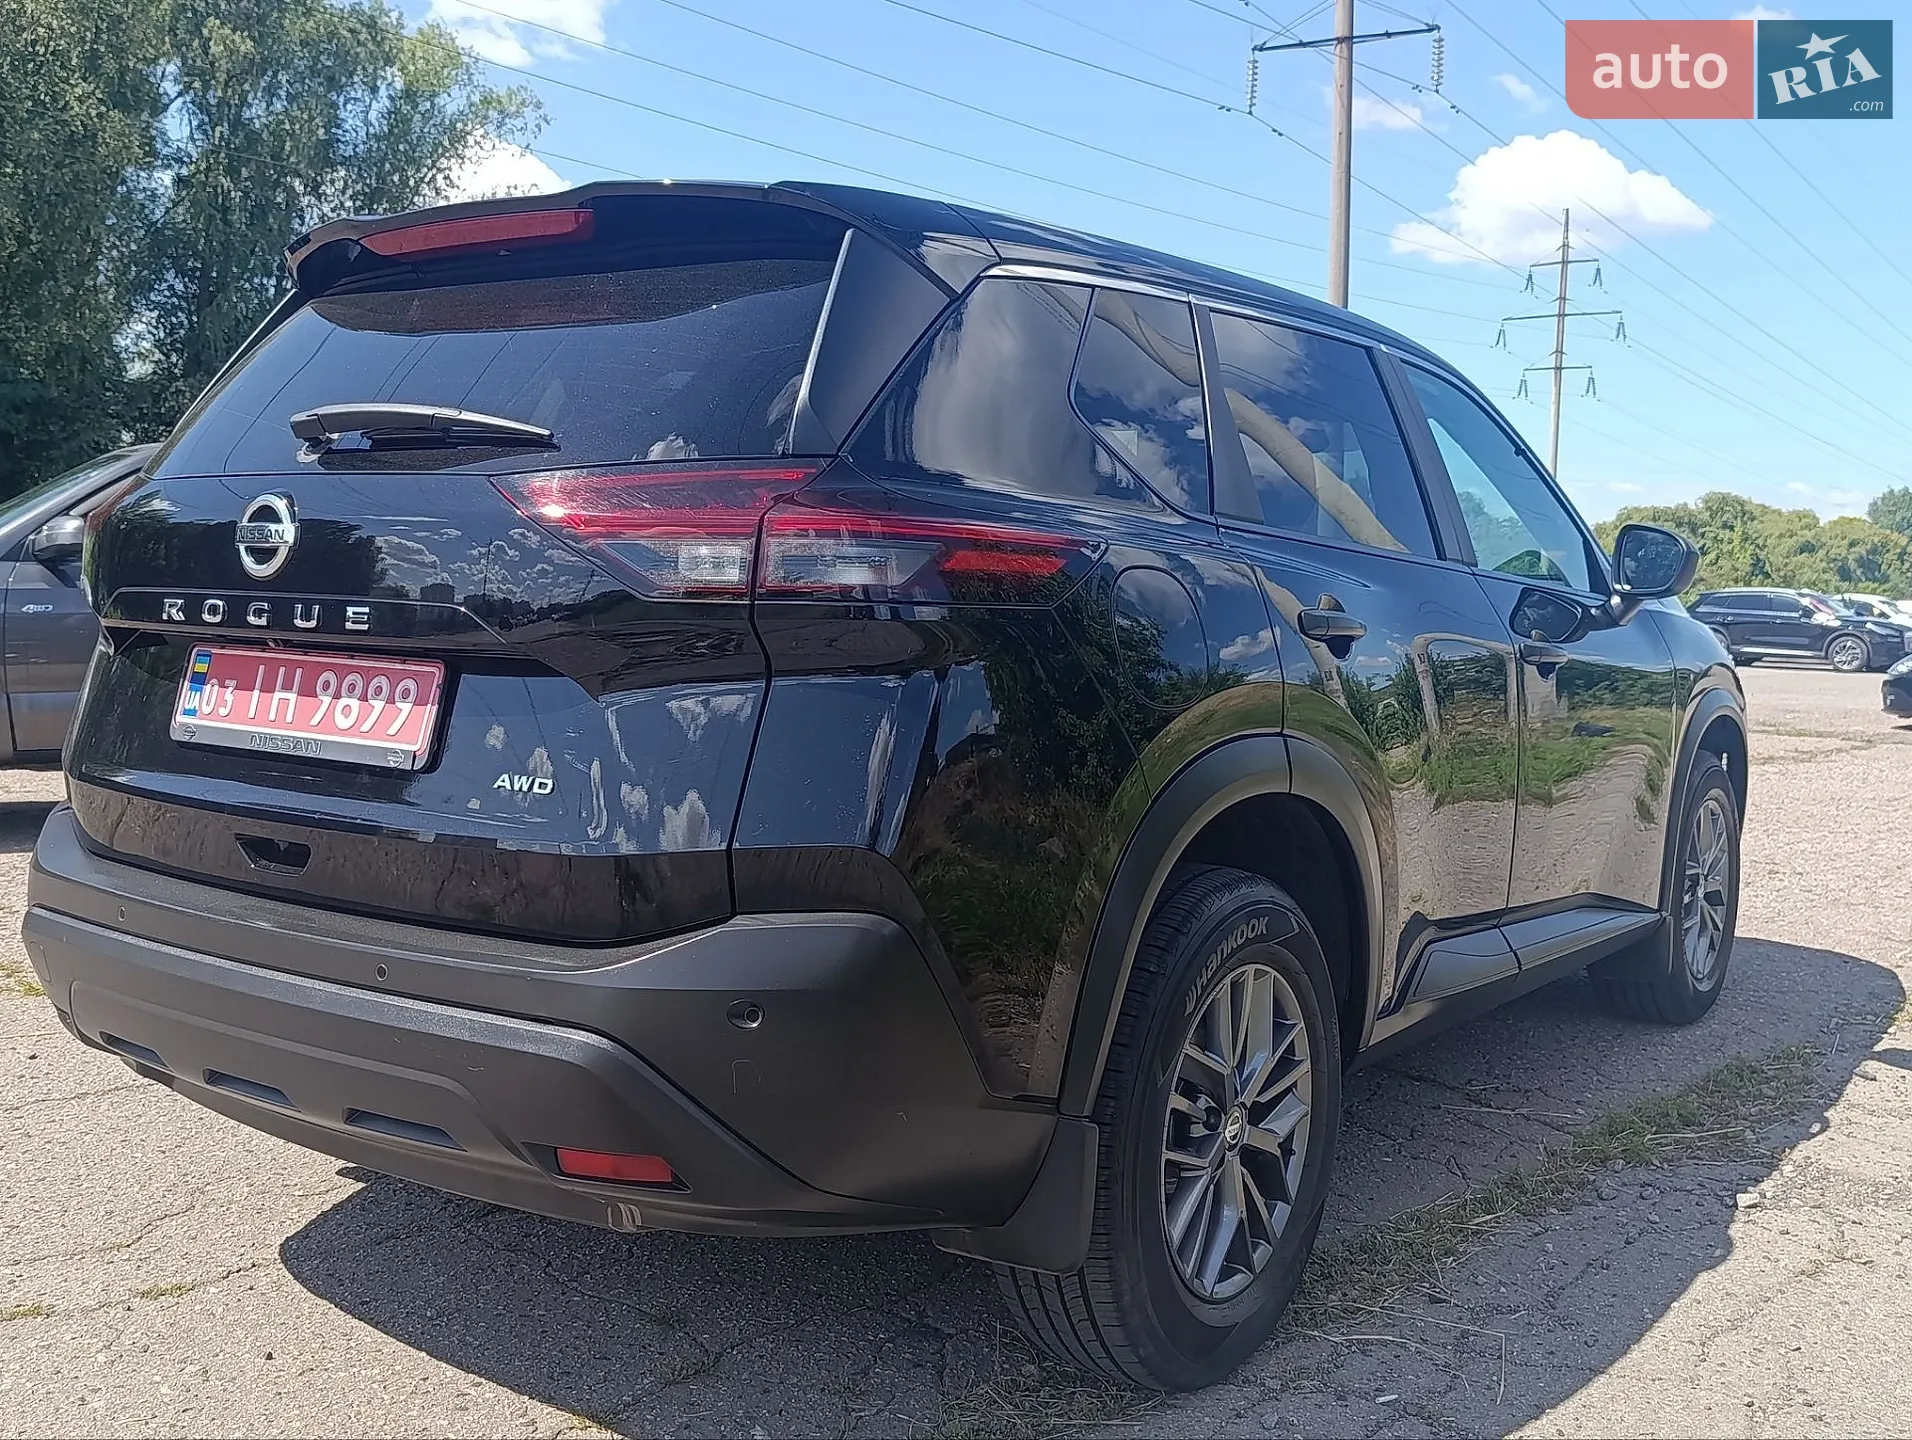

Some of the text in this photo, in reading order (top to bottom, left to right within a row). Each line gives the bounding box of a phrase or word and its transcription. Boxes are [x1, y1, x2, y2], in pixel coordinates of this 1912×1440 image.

[237, 524, 286, 542] NISSAN
[162, 598, 372, 632] ROGUE
[184, 690, 199, 711] UA
[201, 678, 237, 718] 03
[309, 669, 418, 737] 9899
[249, 733, 323, 756] NISSAN
[493, 773, 555, 795] AWD
